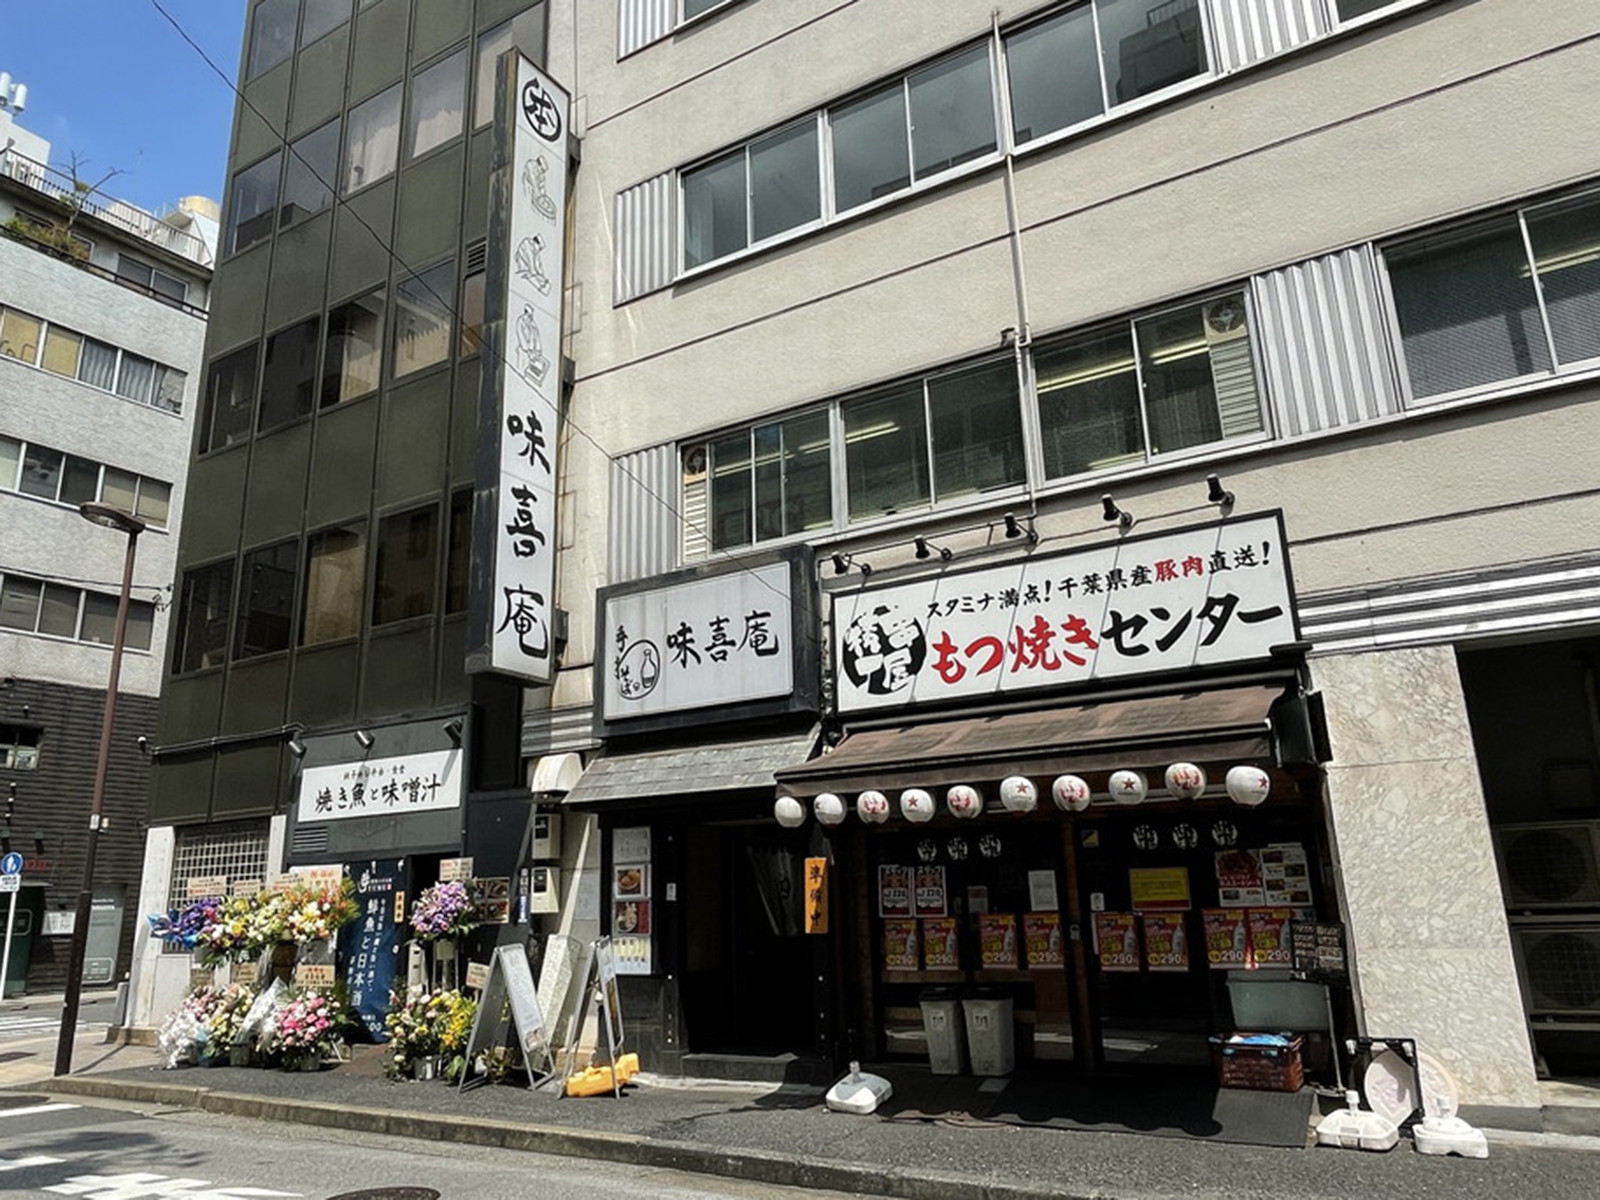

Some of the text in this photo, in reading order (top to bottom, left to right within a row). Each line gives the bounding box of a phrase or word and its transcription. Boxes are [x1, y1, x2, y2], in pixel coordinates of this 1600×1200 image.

[496, 410, 551, 659] 味喜庵
[666, 610, 779, 669] 味喜庵
[931, 593, 1284, 685] もつ焼きセンター
[315, 773, 441, 814] 焼き魚と味噌汁
[351, 898, 379, 1006] 鮮魚と日本酒
[1160, 954, 1182, 964] 290
[1268, 950, 1291, 960] 290
